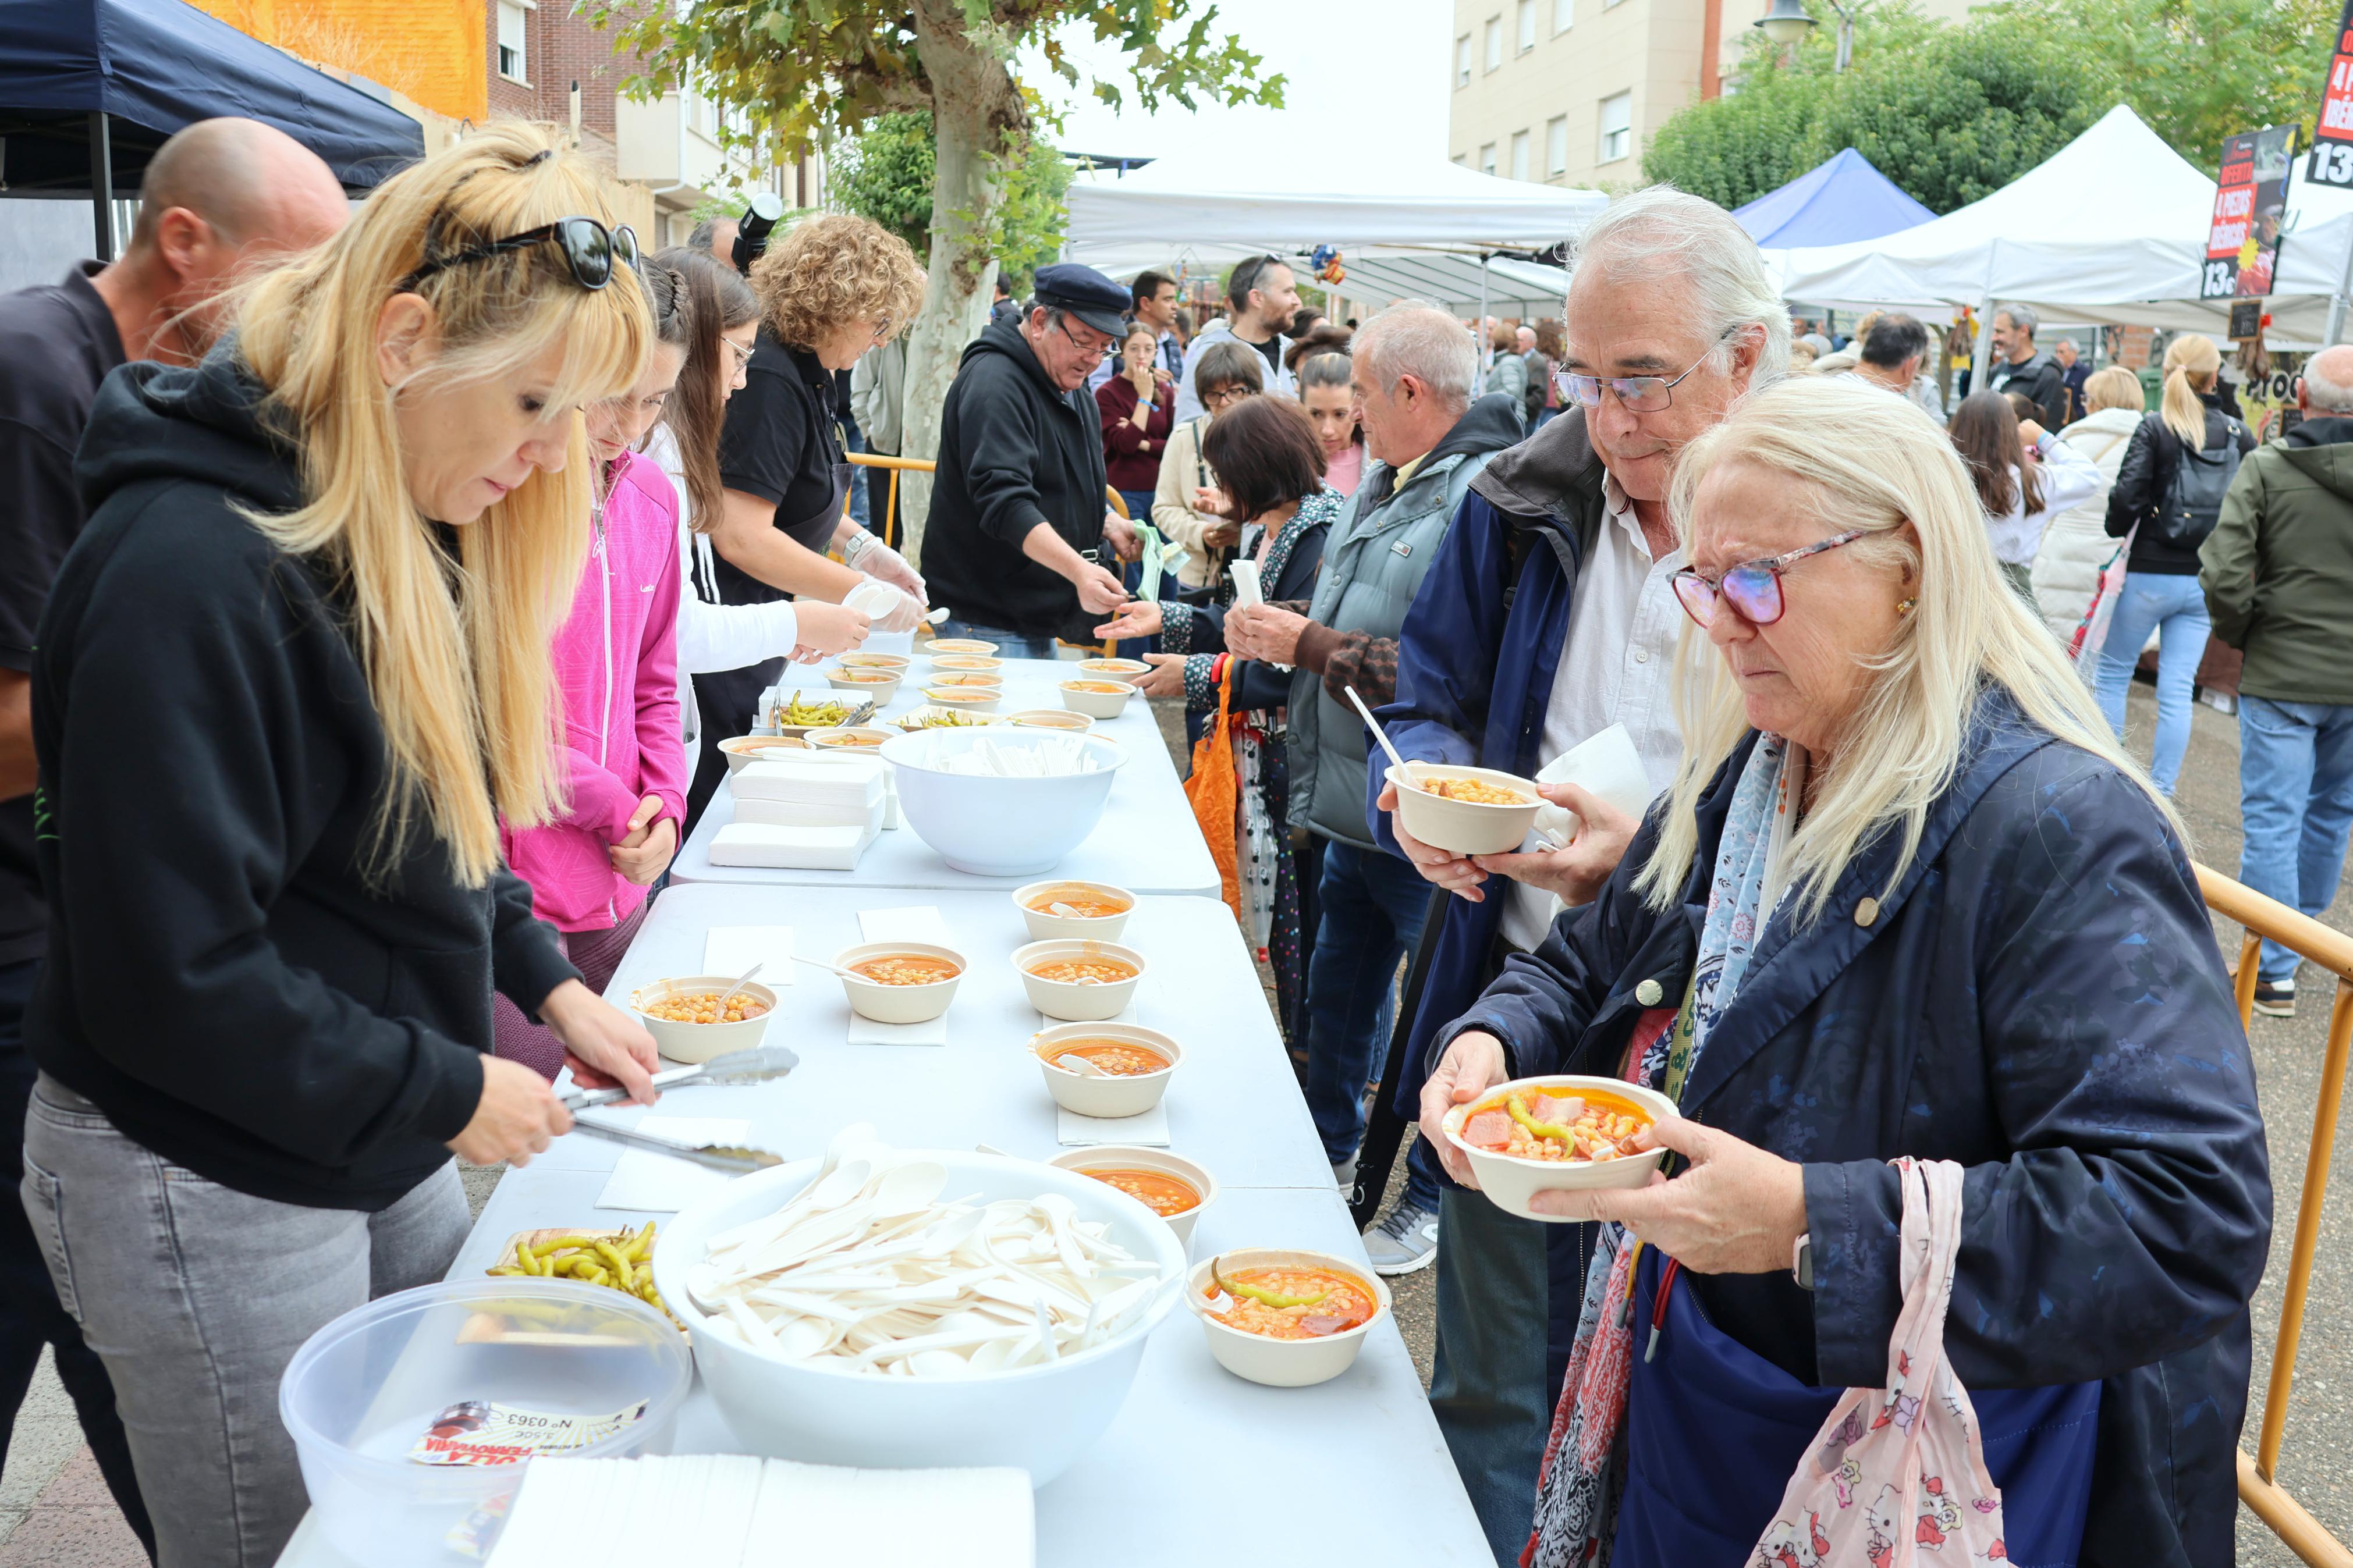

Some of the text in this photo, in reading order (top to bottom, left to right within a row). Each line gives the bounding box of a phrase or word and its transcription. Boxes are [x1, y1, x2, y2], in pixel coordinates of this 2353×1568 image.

[2333, 61, 2347, 91] 4
[2220, 162, 2253, 186] OFERTA
[508, 1414, 548, 1428] 0363
[425, 1438, 534, 1456] FERROVIARIA
